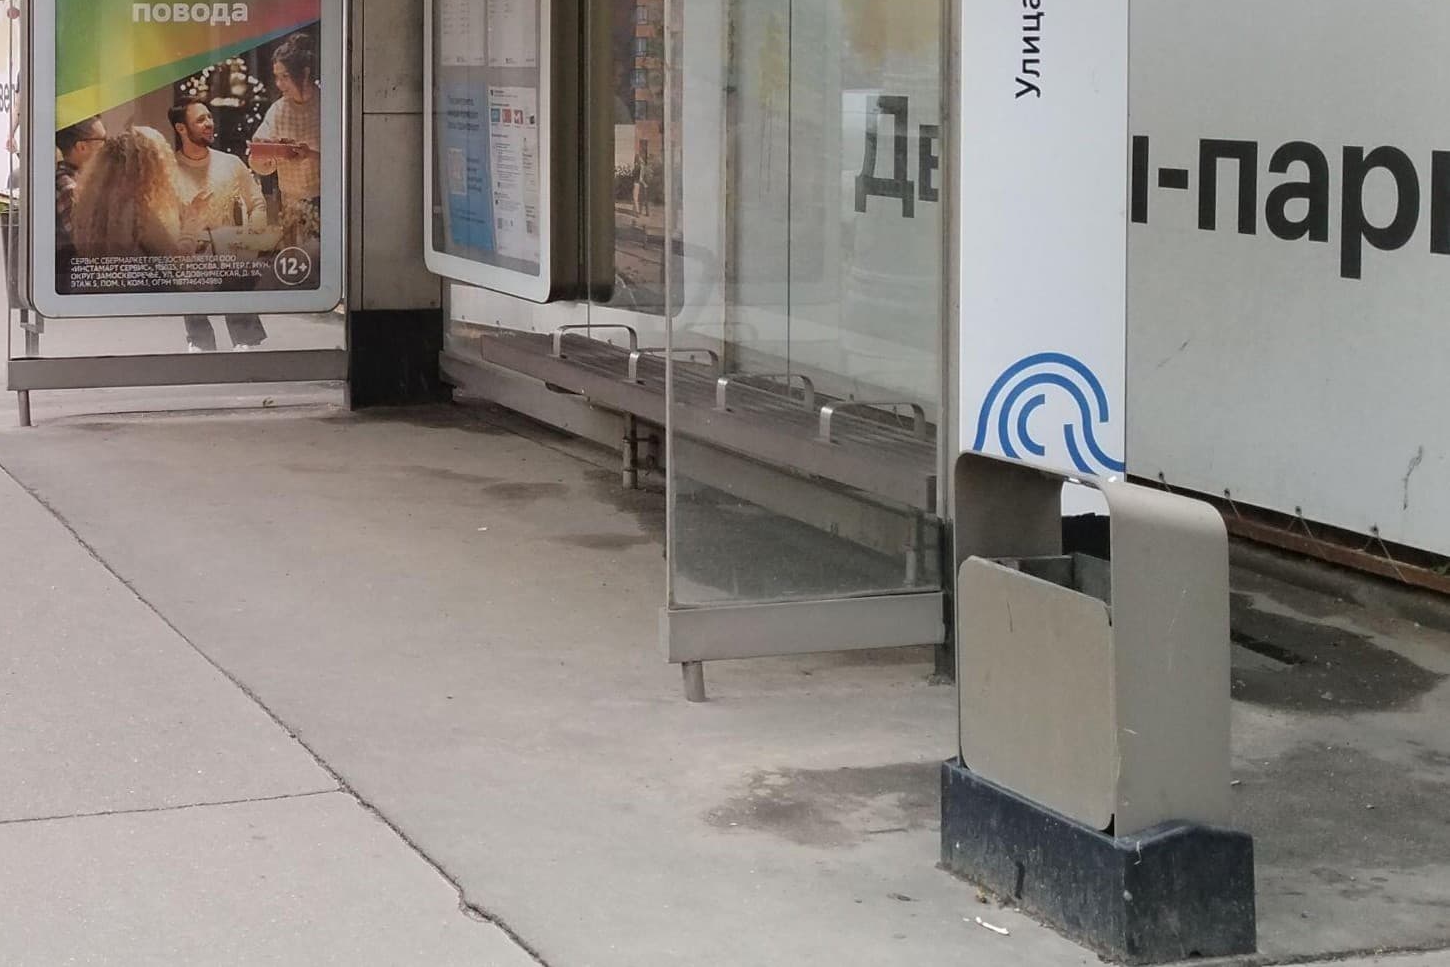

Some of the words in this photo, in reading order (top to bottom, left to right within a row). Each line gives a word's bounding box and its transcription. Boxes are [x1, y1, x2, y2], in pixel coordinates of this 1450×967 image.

[132, 2, 249, 26] повода
[219, 254, 237, 263] ООО
[279, 257, 308, 275] 12+
